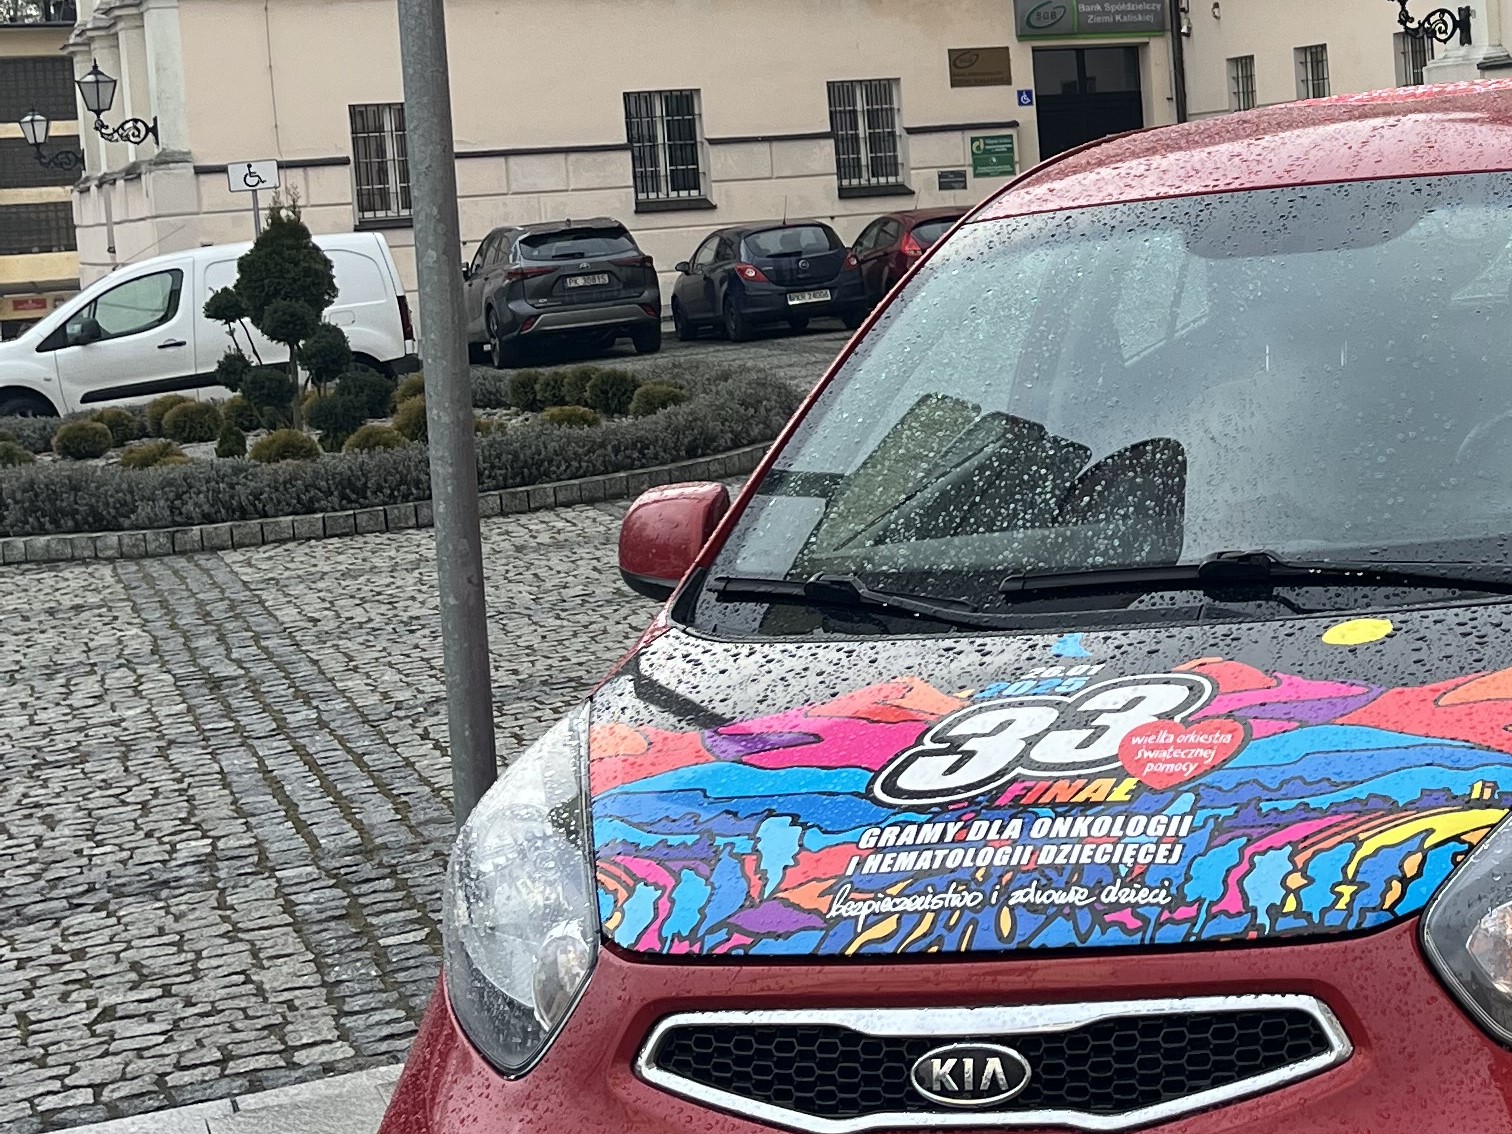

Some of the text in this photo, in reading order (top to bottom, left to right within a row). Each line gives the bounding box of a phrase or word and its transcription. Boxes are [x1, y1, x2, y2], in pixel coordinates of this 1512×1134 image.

[1078, 2, 1162, 13] Bank Spółdzielczy
[1087, 13, 1154, 23] Ziemi Kaliskiej
[1025, 663, 1106, 679] 26.01
[974, 676, 1090, 699] 2025
[890, 681, 1195, 793] 33
[1130, 730, 1233, 746] wielka orkiestra
[1135, 744, 1216, 760] świątecznej
[1143, 760, 1199, 776] pomocy
[994, 777, 1140, 805] FINAŁ
[858, 815, 1195, 850] GRAMY DLA ONKOLOGII
[845, 843, 1183, 876] I HEMATOLOGII DZIECIĘCEJ
[826, 878, 1172, 931] bezpieczeństwo i zdrowie dzieci
[930, 1057, 1009, 1091] KIA
